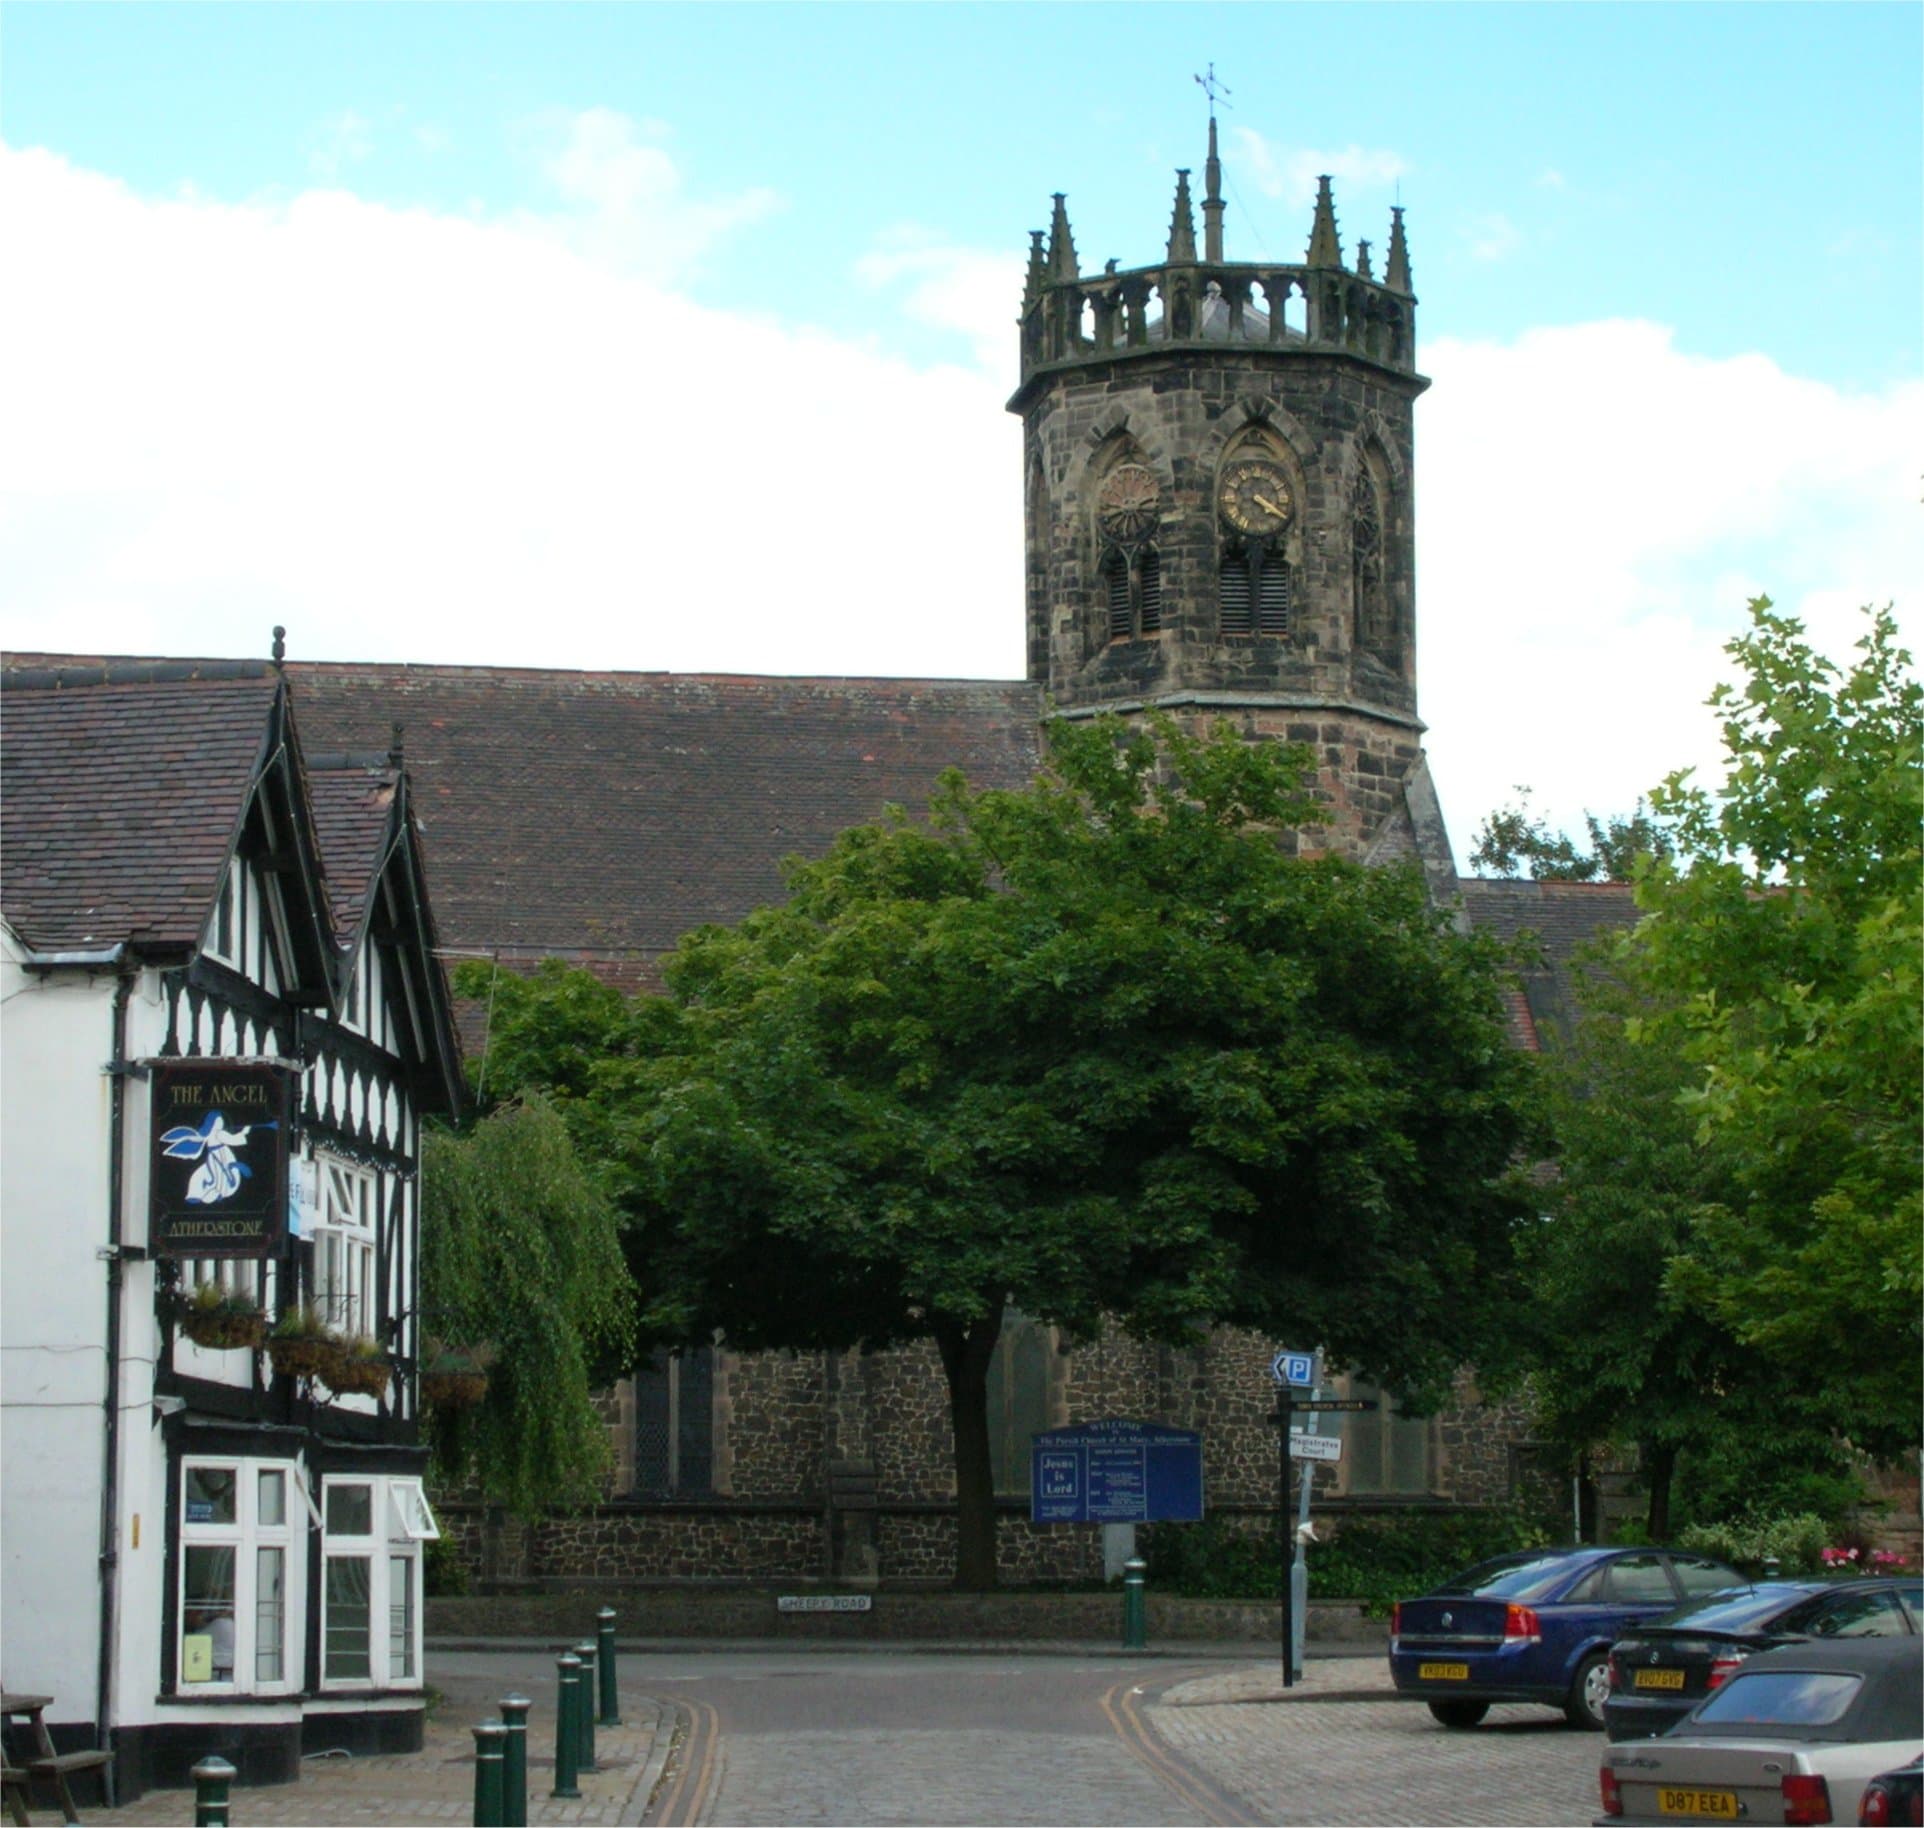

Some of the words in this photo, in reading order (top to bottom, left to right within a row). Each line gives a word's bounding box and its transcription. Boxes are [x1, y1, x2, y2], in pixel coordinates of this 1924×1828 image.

[170, 1085, 202, 1104] THE
[210, 1085, 268, 1104] ANGEL
[168, 1220, 264, 1237] ATHERSTONE
[1293, 1360, 1305, 1379] P
[1302, 1446, 1325, 1456] Court
[1044, 1457, 1074, 1469] Jesus
[1054, 1470, 1065, 1481] is
[1046, 1483, 1073, 1494] Lord
[833, 1597, 866, 1609] ROAD
[1665, 1791, 1695, 1810] D87
[1699, 1793, 1729, 1812] EEA
